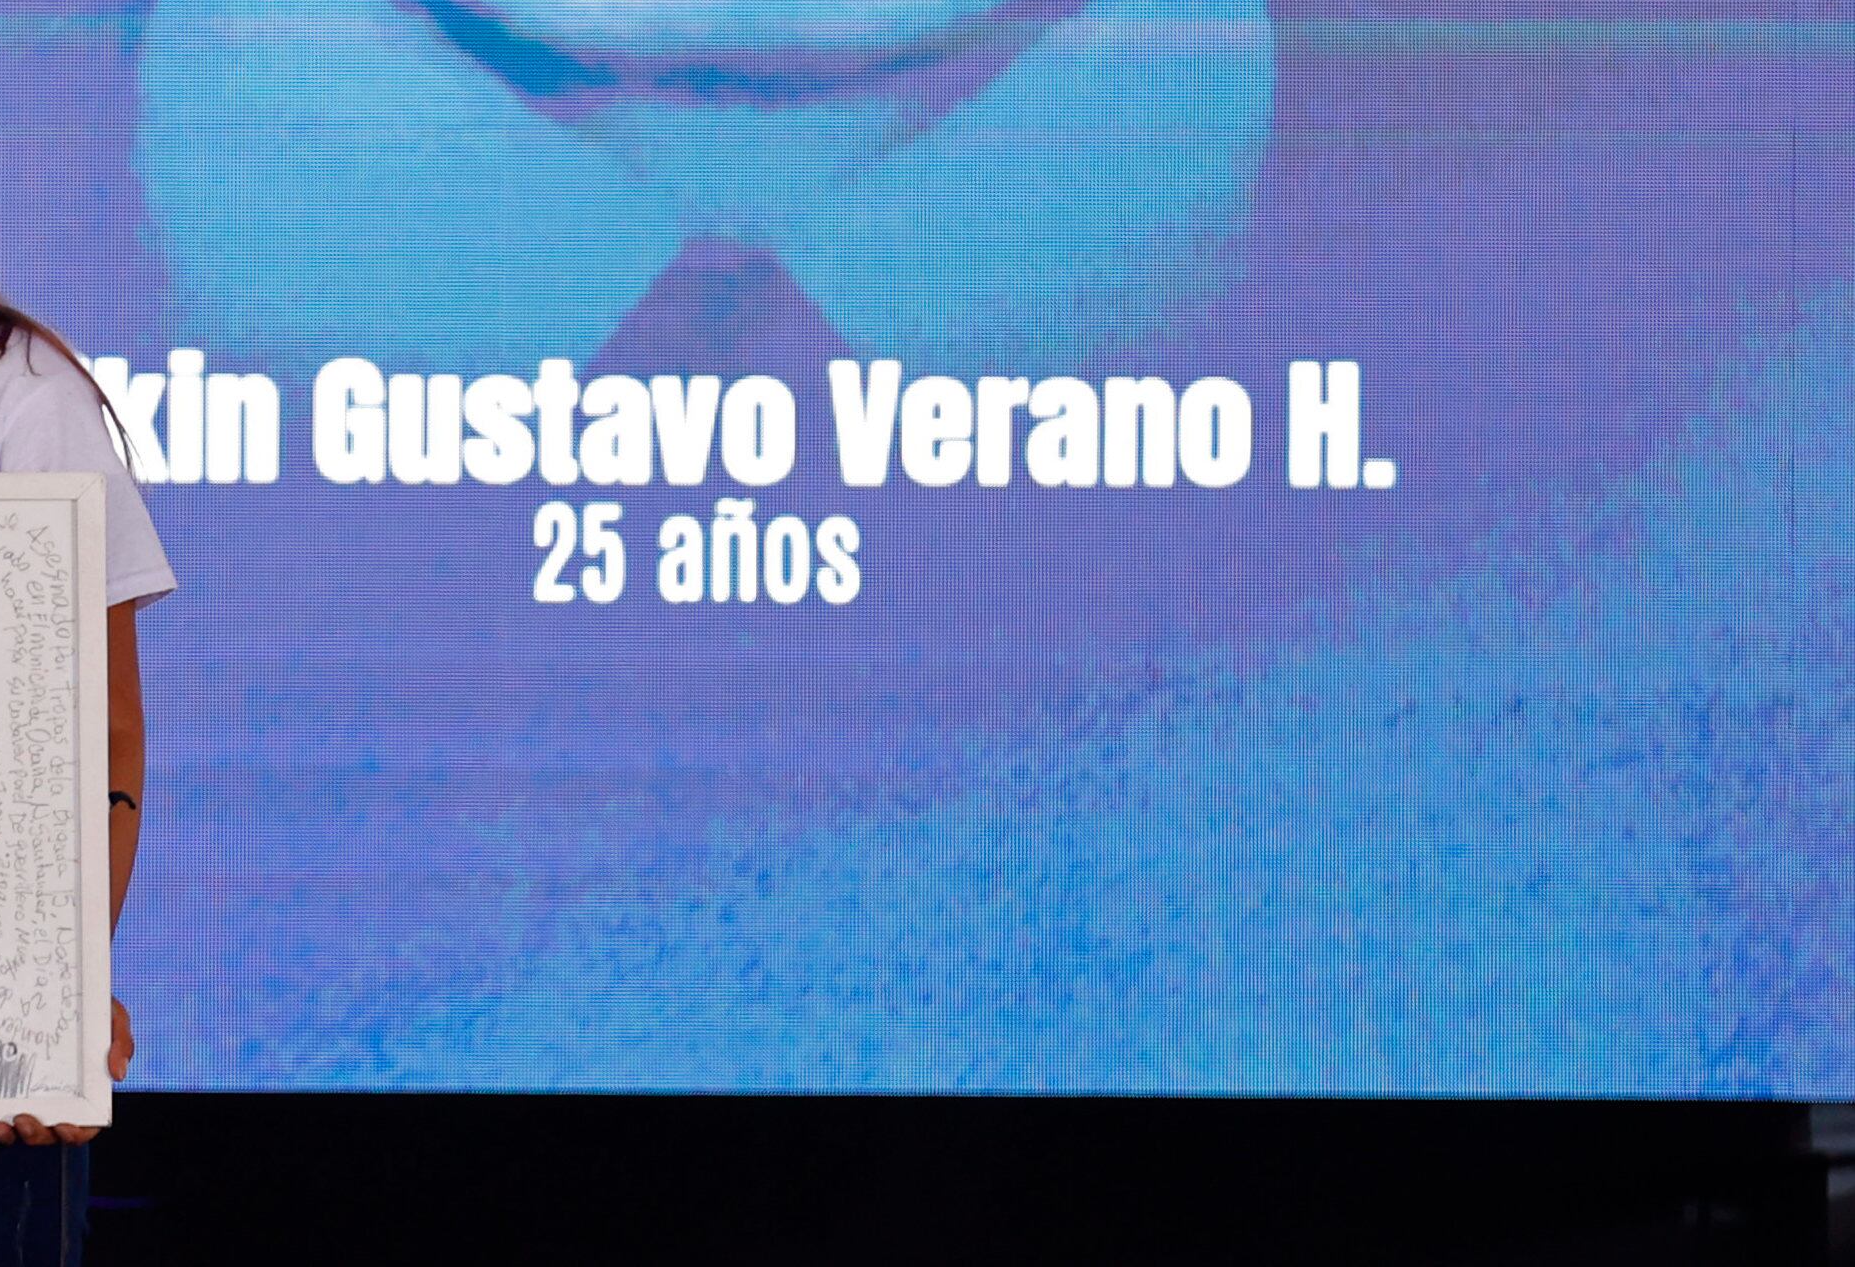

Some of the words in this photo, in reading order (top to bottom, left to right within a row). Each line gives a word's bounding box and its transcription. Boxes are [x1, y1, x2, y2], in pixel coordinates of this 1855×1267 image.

[311, 357, 797, 487] Gustavo
[826, 361, 1254, 489] Verano
[1286, 359, 1398, 489] H.
[531, 500, 626, 605] 25
[656, 496, 861, 606] años
